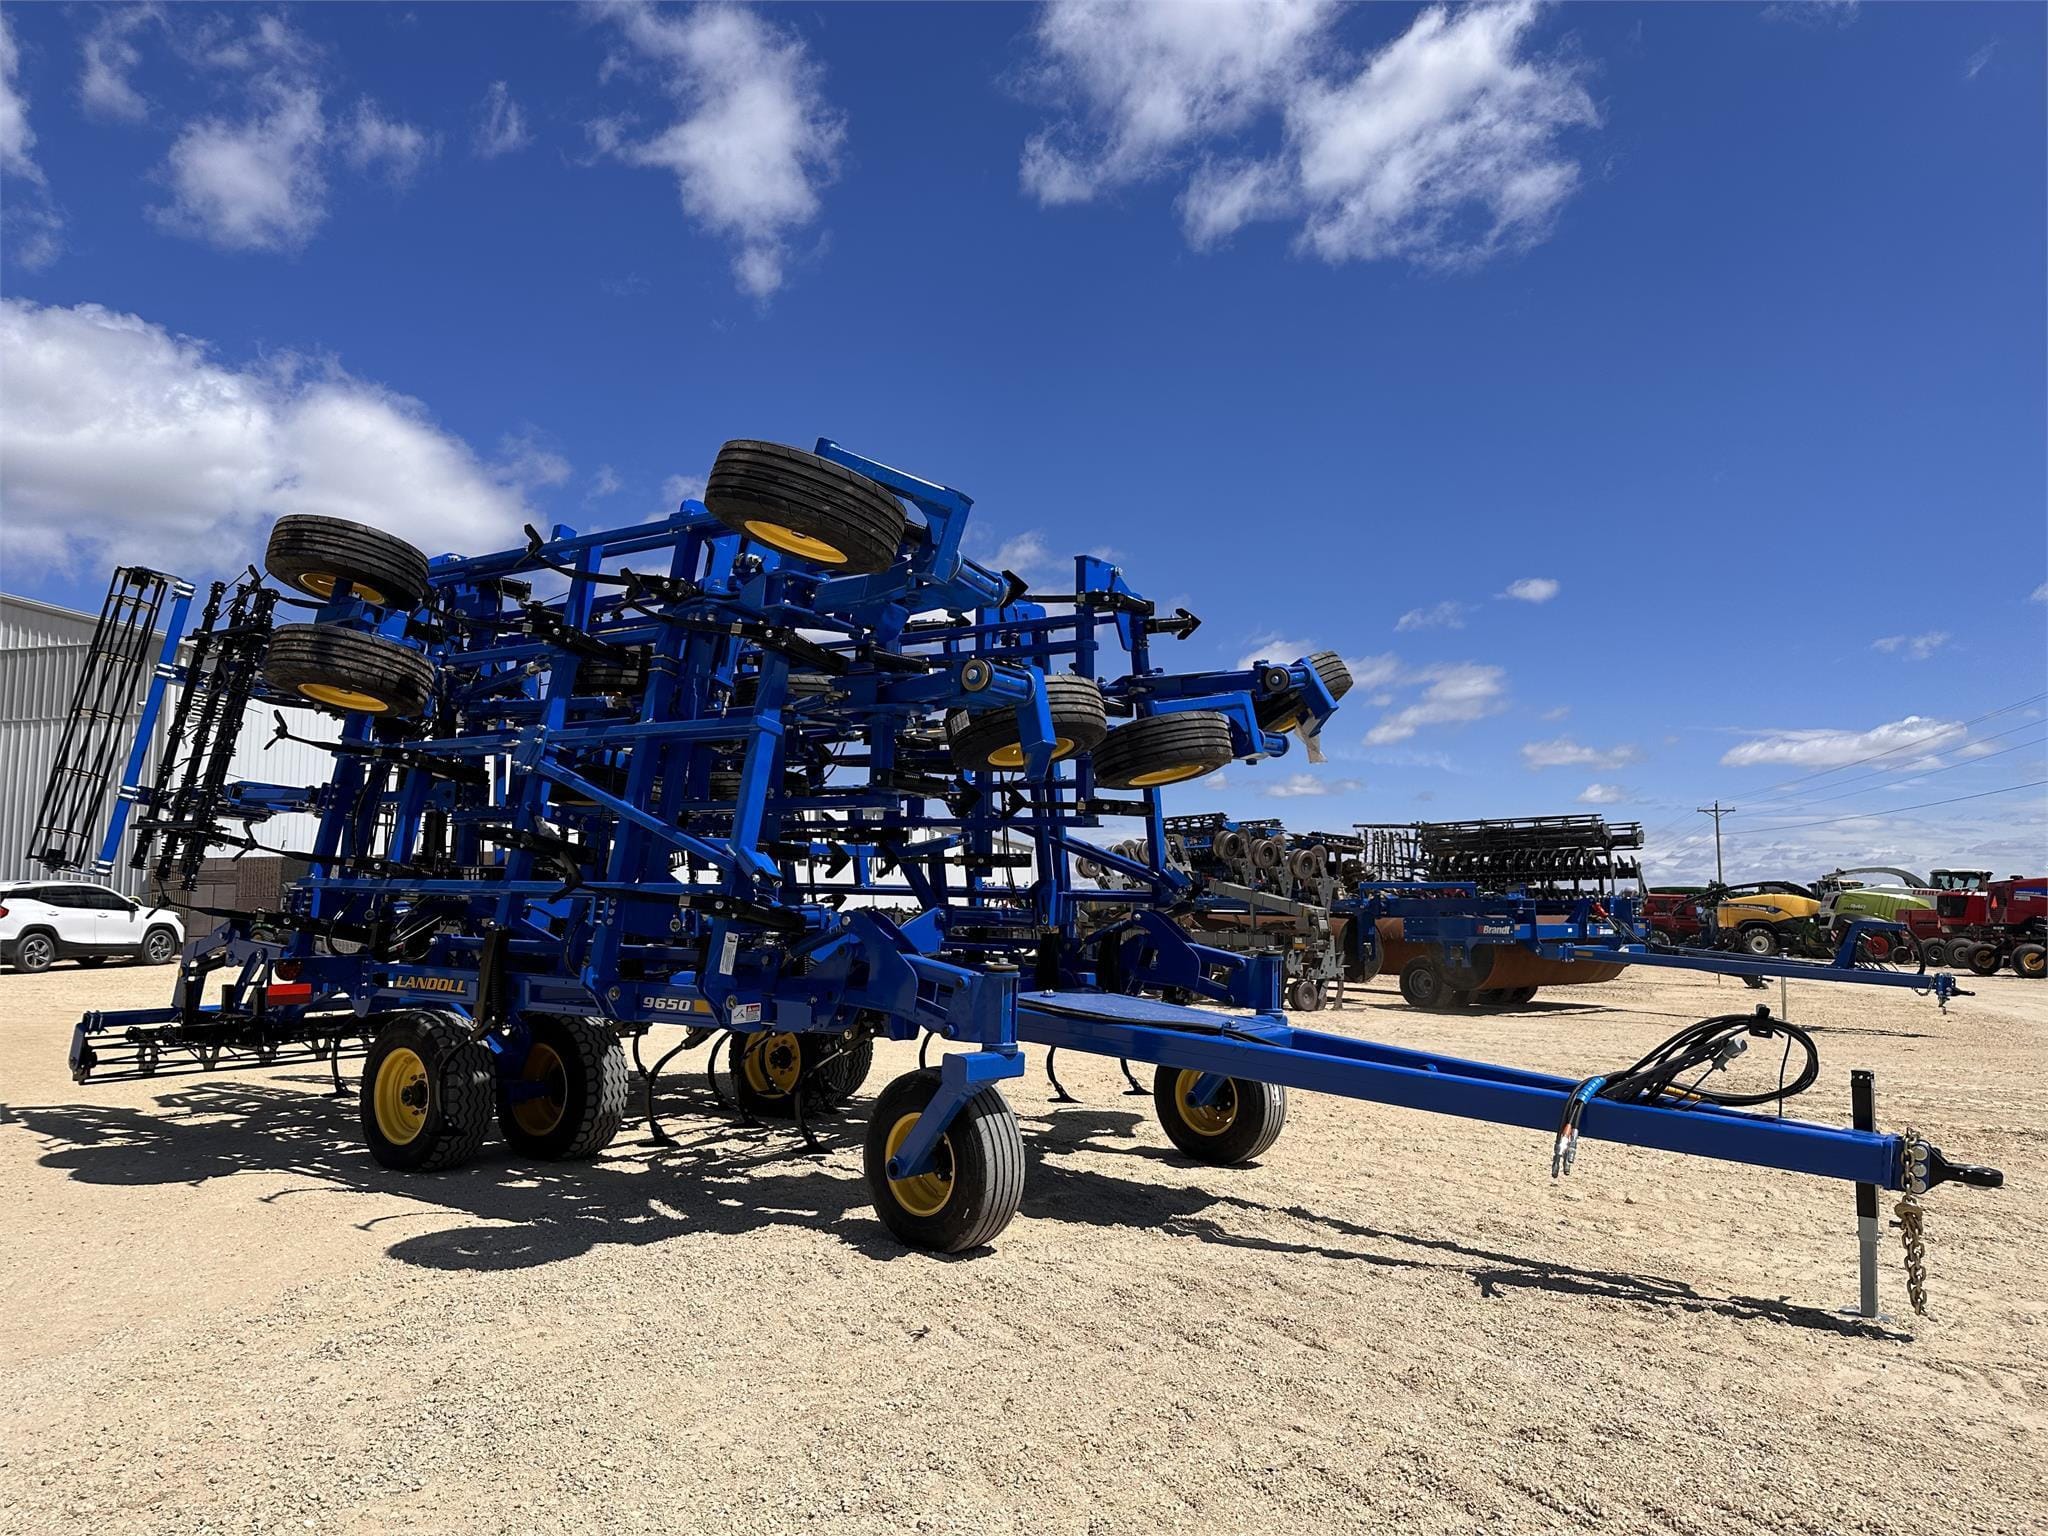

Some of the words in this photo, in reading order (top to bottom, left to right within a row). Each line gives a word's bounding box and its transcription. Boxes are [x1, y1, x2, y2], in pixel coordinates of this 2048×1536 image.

[1483, 925, 1511, 934] Brandt
[396, 975, 466, 993] LANDOLL
[643, 996, 691, 1012] 9650
